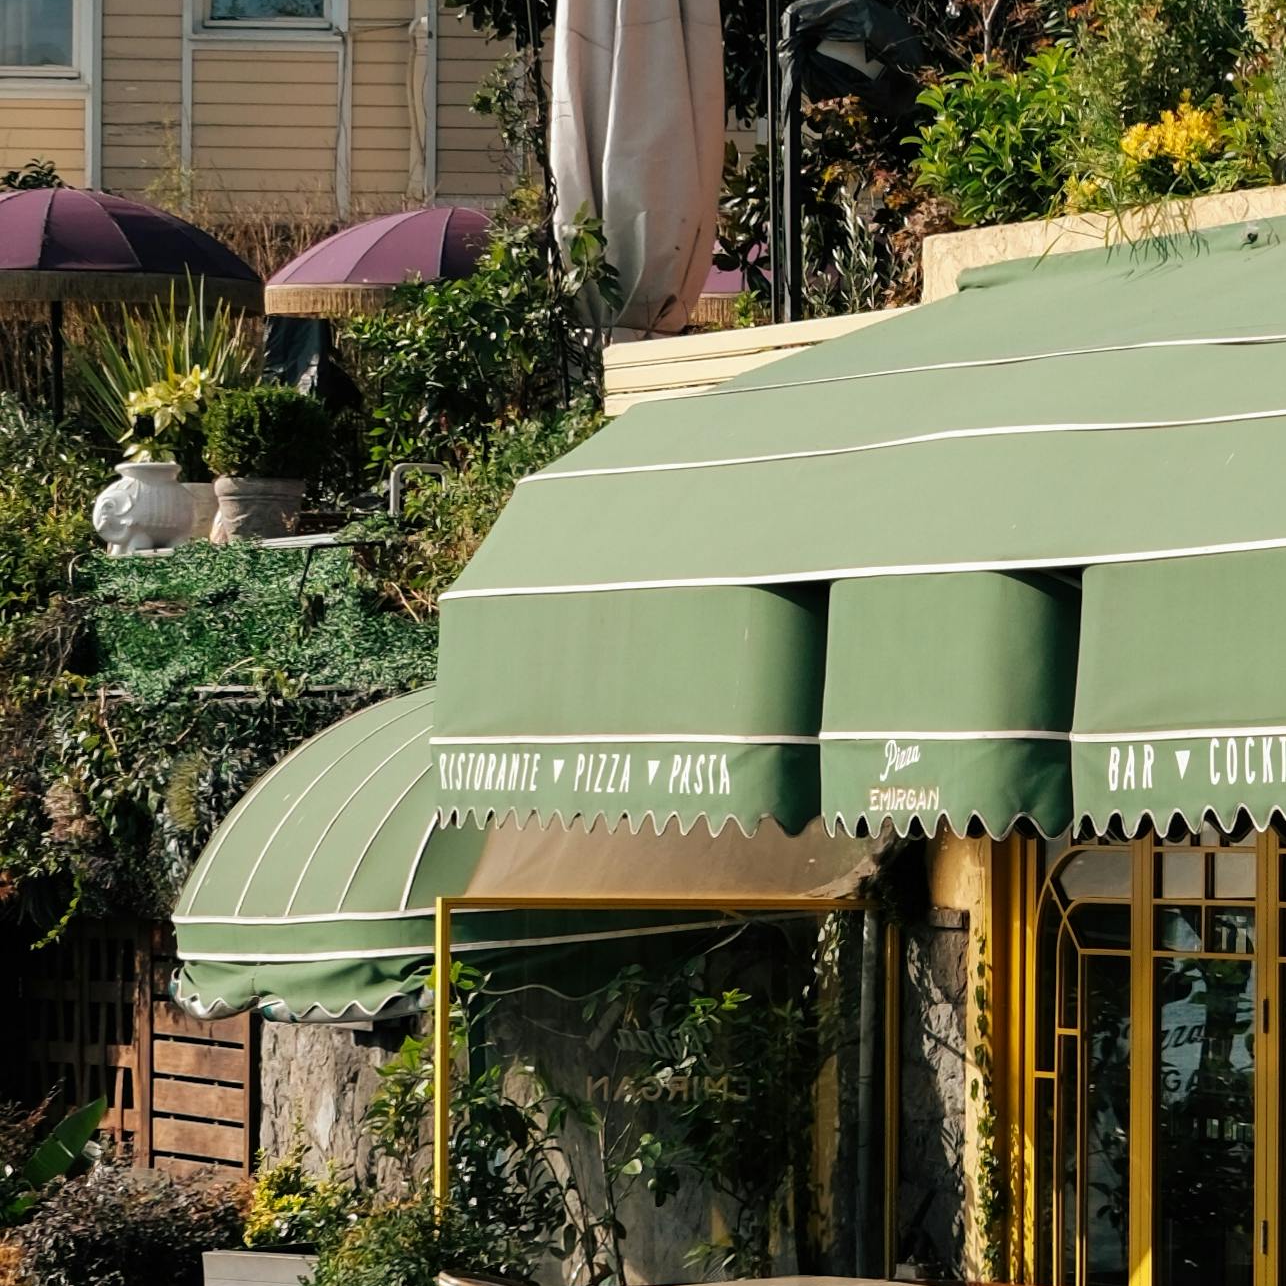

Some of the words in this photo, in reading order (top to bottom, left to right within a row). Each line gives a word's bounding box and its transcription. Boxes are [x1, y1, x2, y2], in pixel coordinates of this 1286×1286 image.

[439, 753, 541, 791] RISTORANTE
[573, 754, 631, 793] PIZZA
[669, 754, 731, 795] PASTA
[880, 739, 921, 782] Pizza
[1108, 743, 1155, 791] BAR
[868, 787, 940, 811] EMIRGAN
